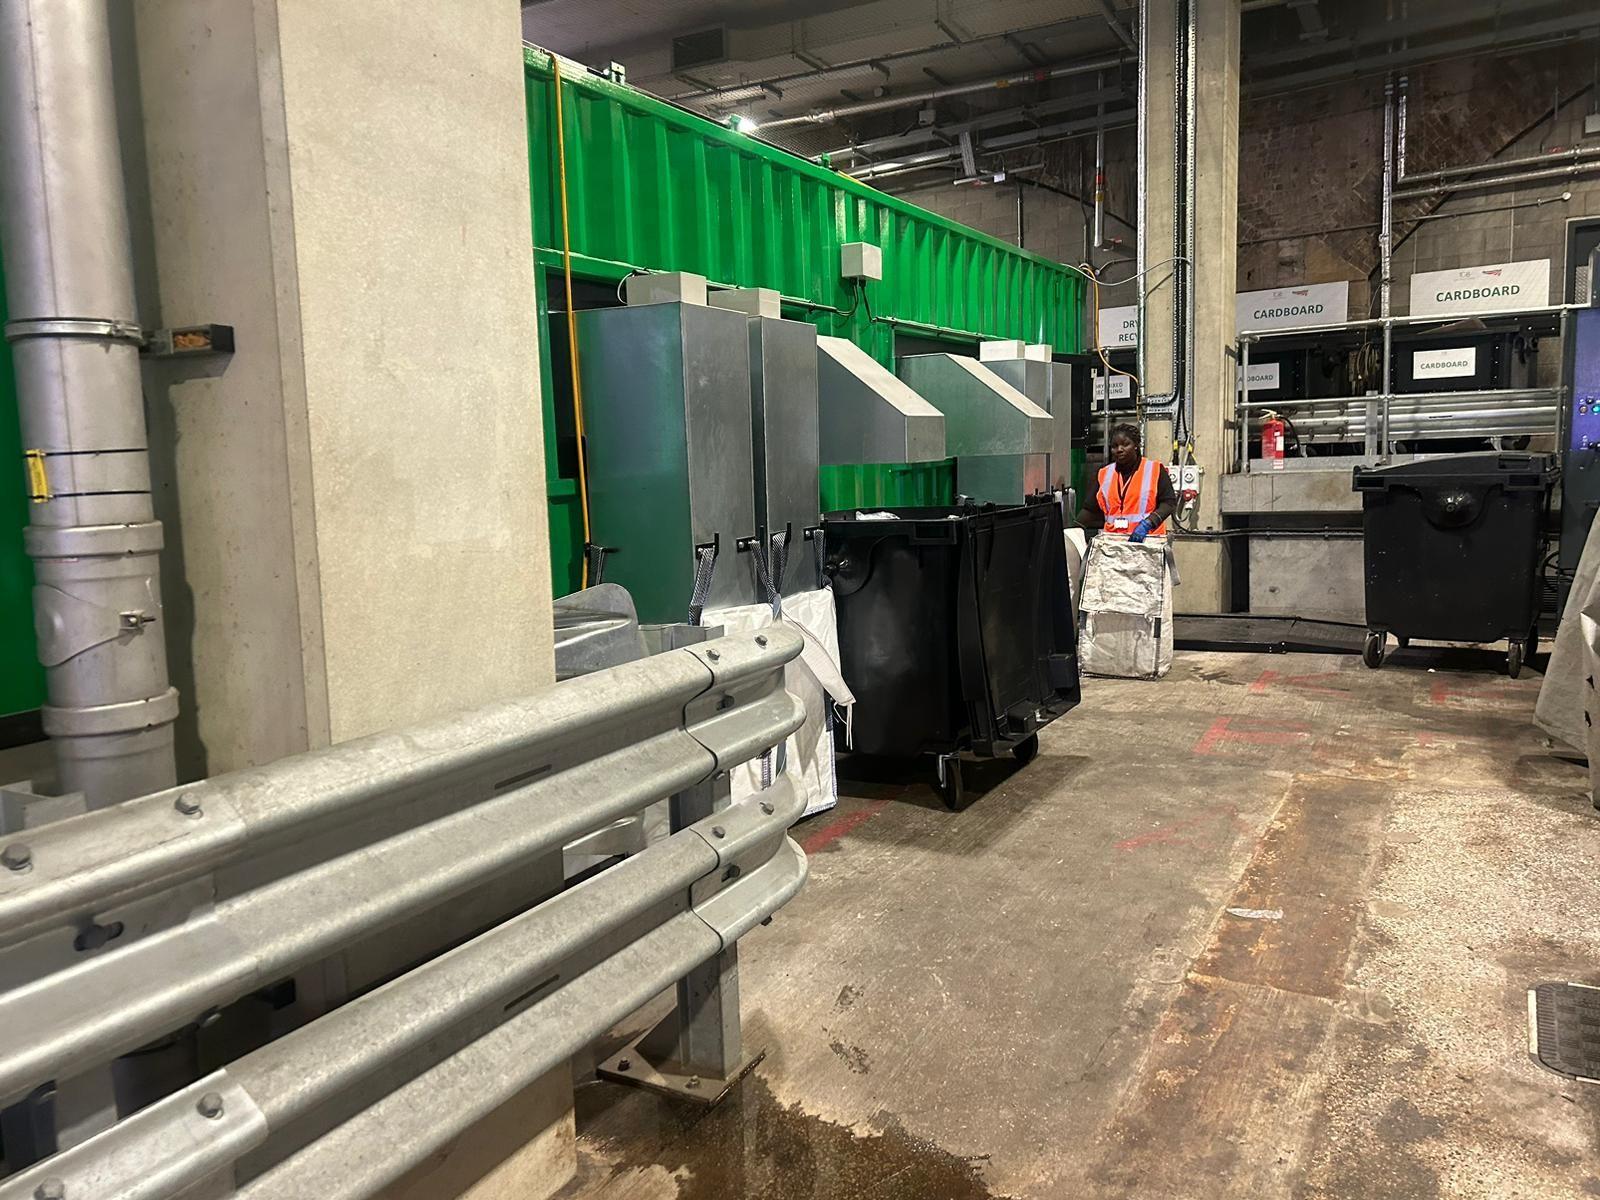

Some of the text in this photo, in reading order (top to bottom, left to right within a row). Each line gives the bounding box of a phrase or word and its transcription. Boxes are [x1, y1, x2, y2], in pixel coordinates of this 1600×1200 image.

[1436, 285, 1520, 302] CARDBOARD
[1253, 304, 1324, 319] CARDBOARD
[1420, 360, 1468, 370] CARDBOARD
